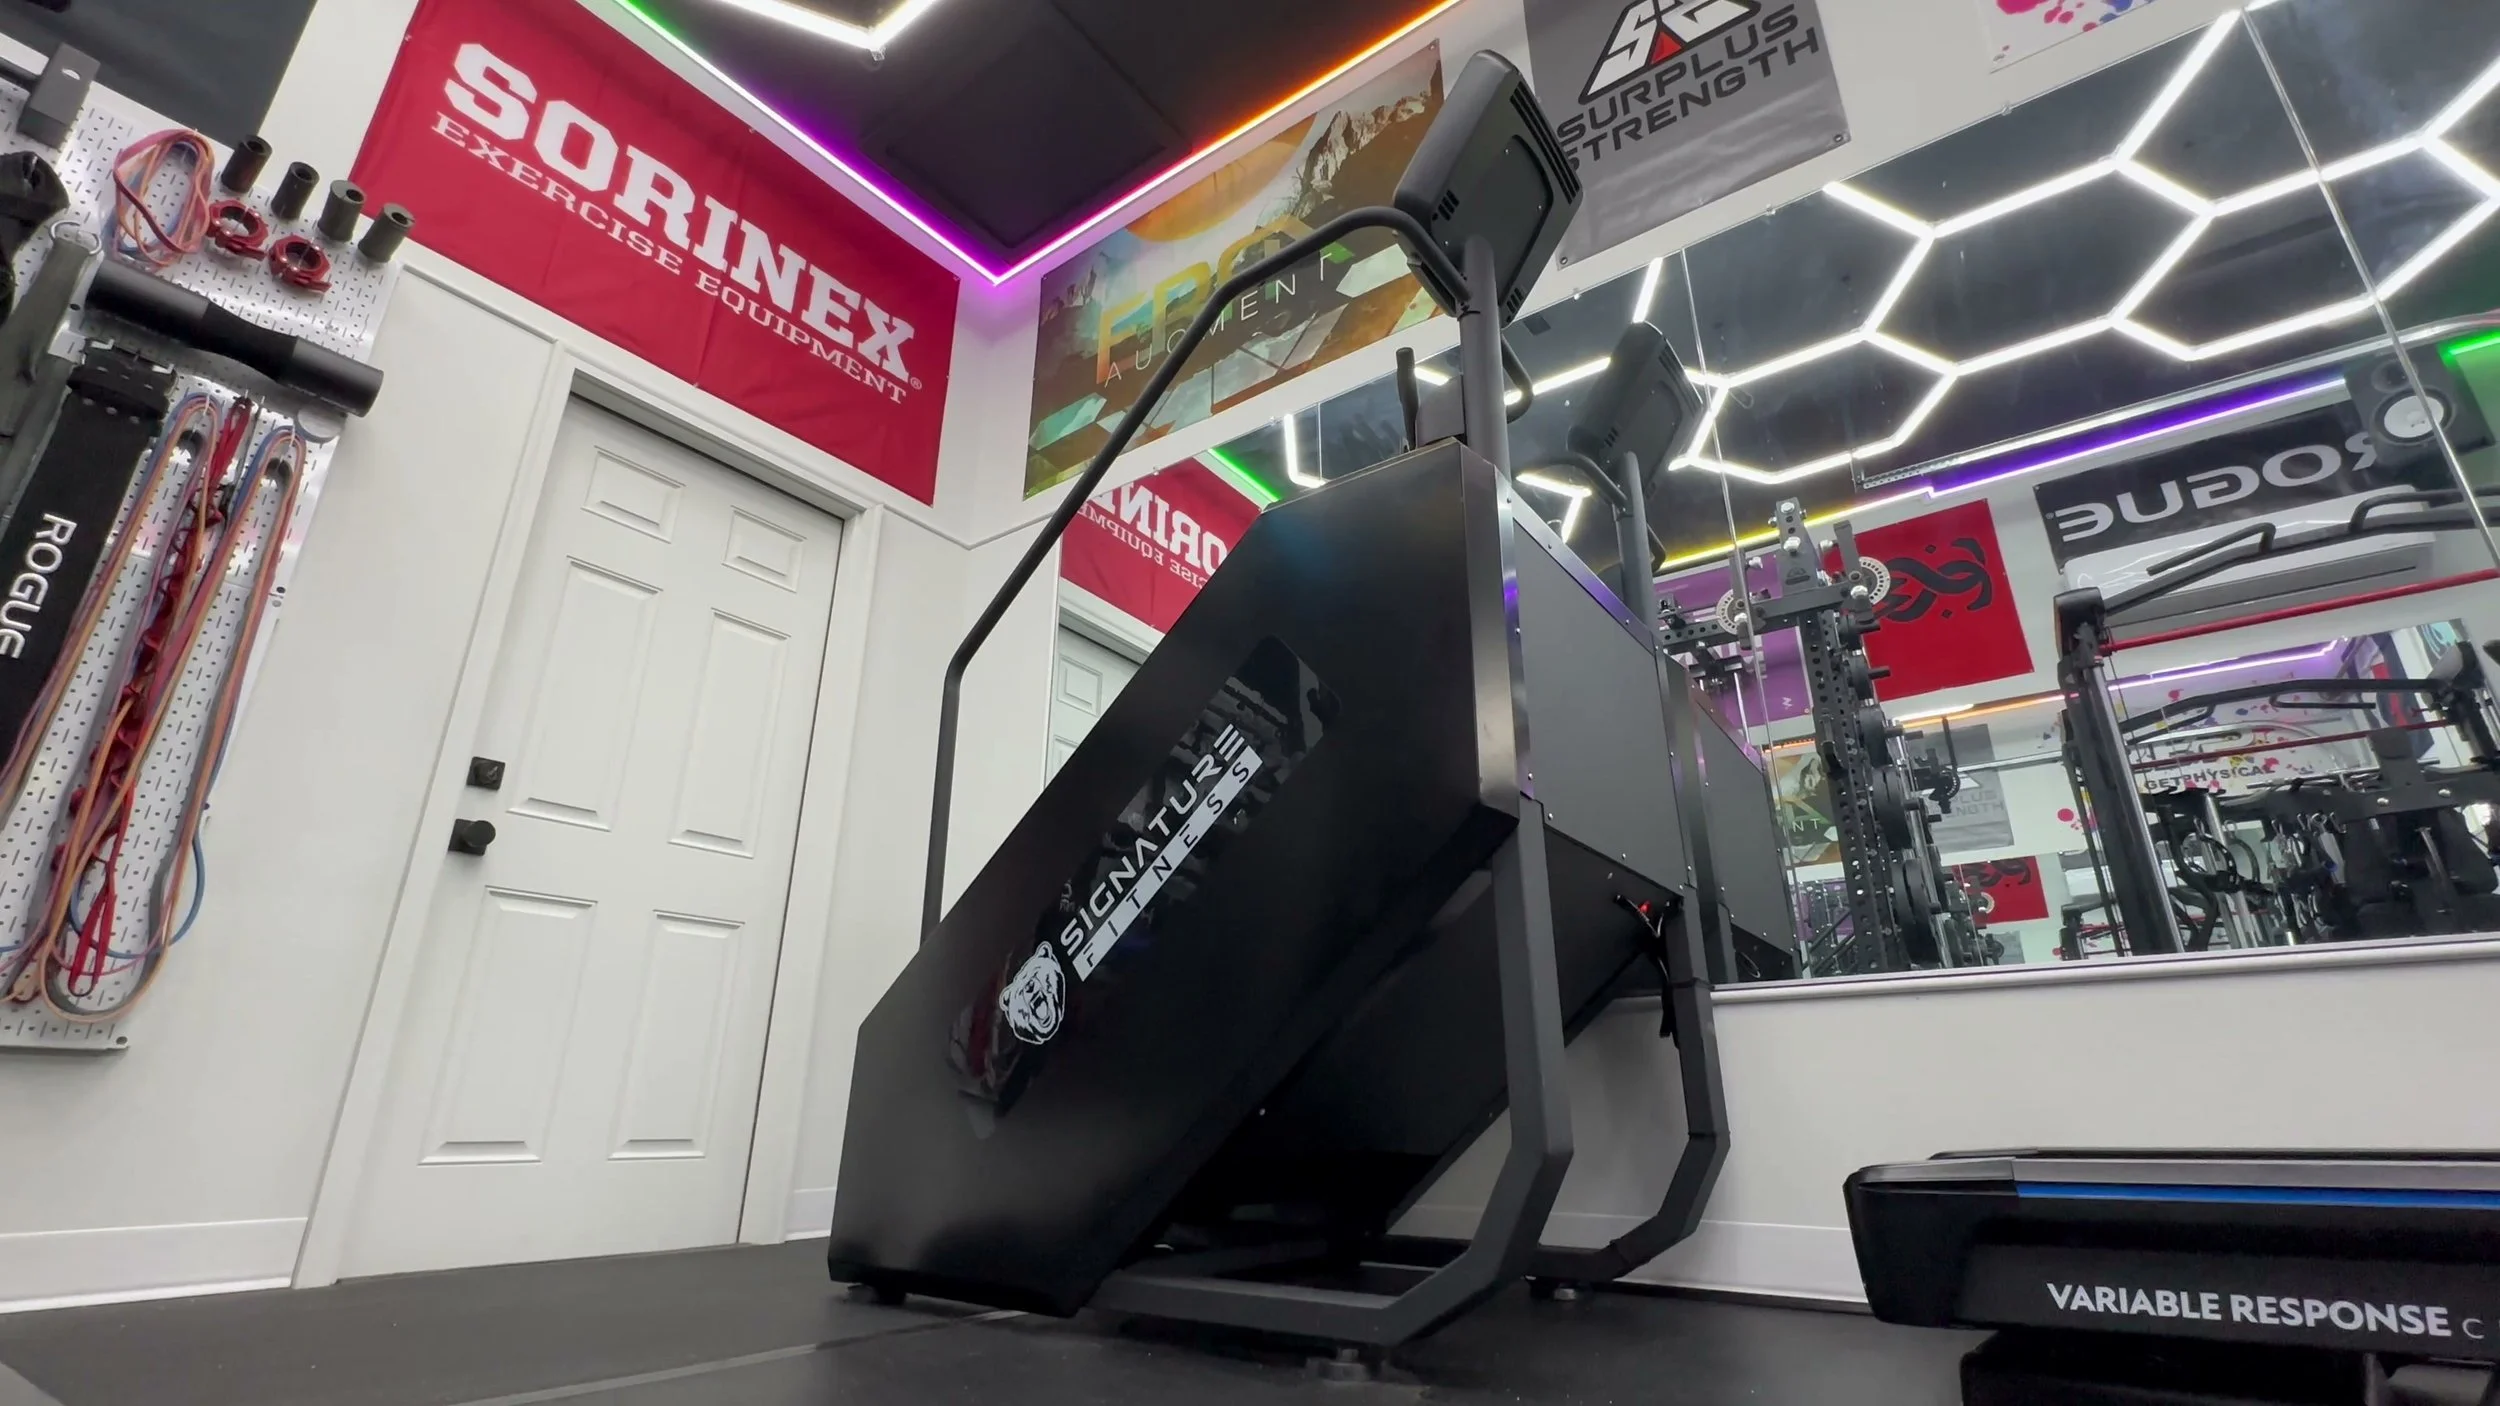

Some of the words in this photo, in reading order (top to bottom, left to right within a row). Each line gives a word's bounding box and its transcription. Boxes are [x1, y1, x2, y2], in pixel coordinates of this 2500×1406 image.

[1557, 4, 1798, 147] SURPLUS
[431, 111, 681, 275] EXERCISE
[695, 270, 907, 404] EQUIPMENT
[444, 43, 914, 382] SORINEX
[1060, 724, 1244, 956] SIGNATURE
[1083, 762, 1249, 967] FITNESS
[2047, 1283, 2222, 1321] VARIABLE
[2230, 1294, 2452, 1337] RESPONSE
